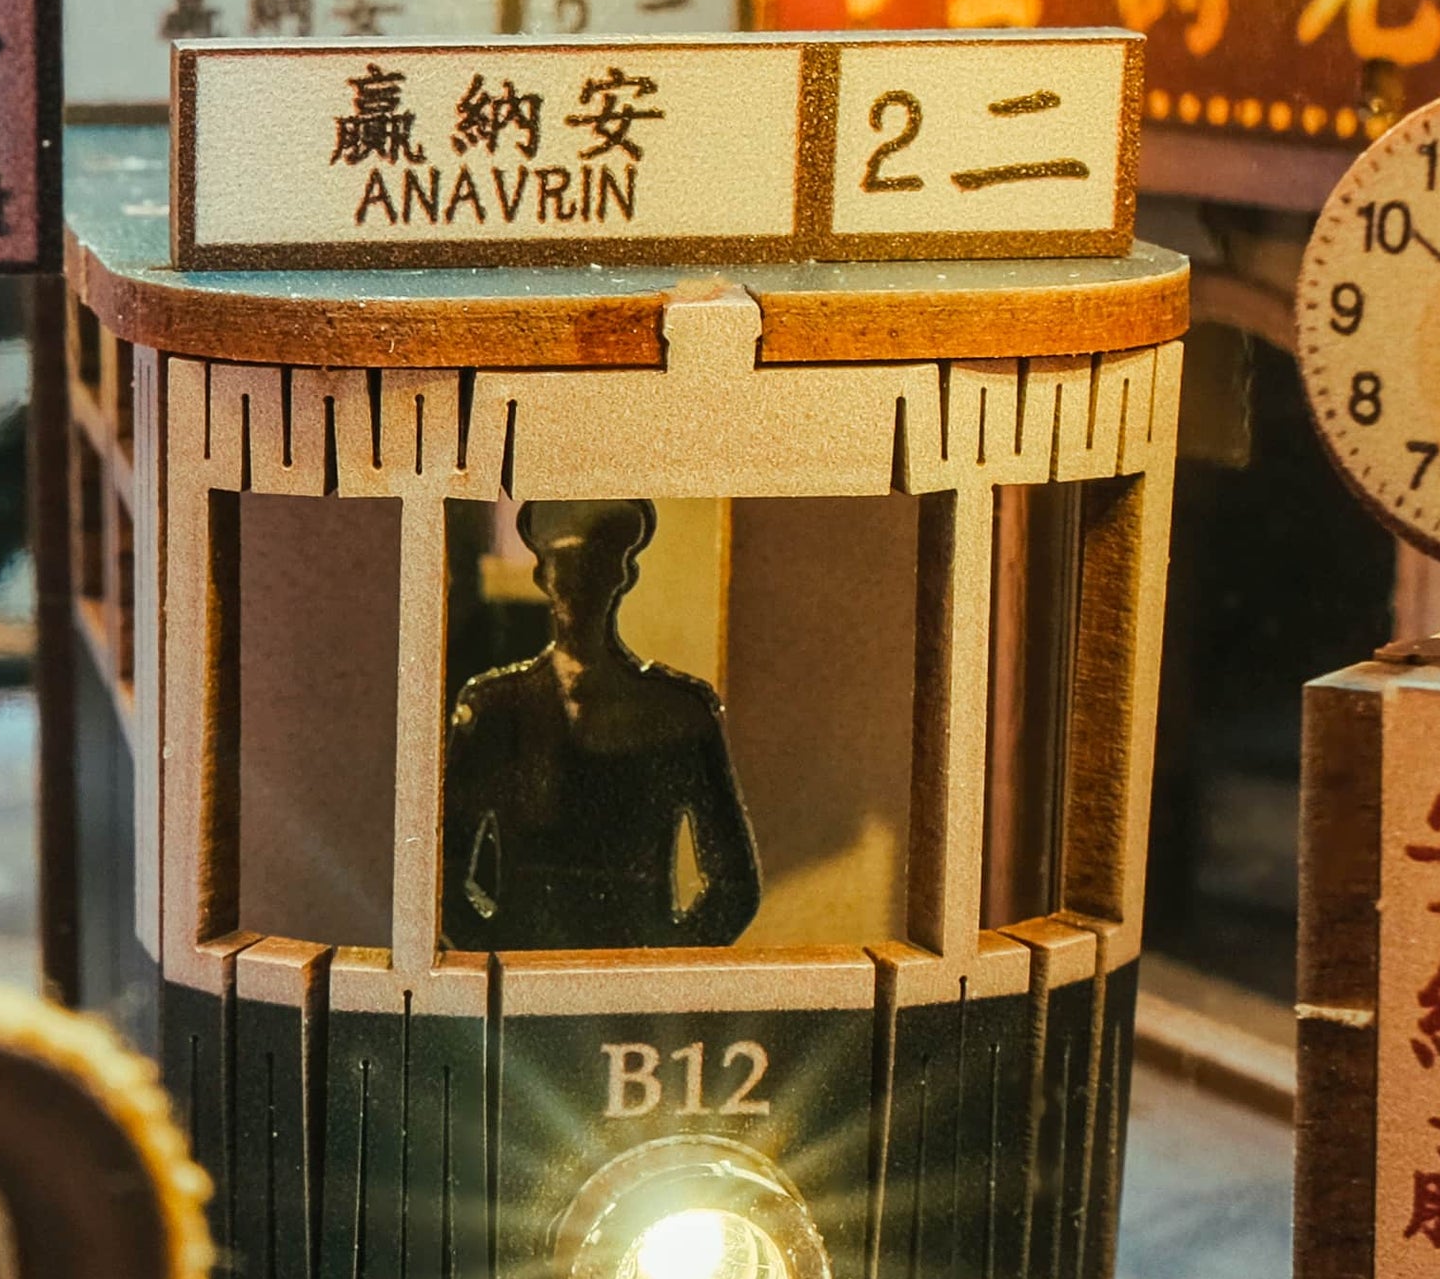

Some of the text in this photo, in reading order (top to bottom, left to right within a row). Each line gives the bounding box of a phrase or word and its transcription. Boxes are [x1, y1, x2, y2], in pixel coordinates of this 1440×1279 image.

[354, 162, 638, 226] ANAVRIN
[1356, 199, 1414, 255] 10
[1329, 281, 1364, 336] 9
[1348, 370, 1383, 426] 8
[1405, 440, 1440, 491] 7
[599, 1039, 771, 1119] B12
